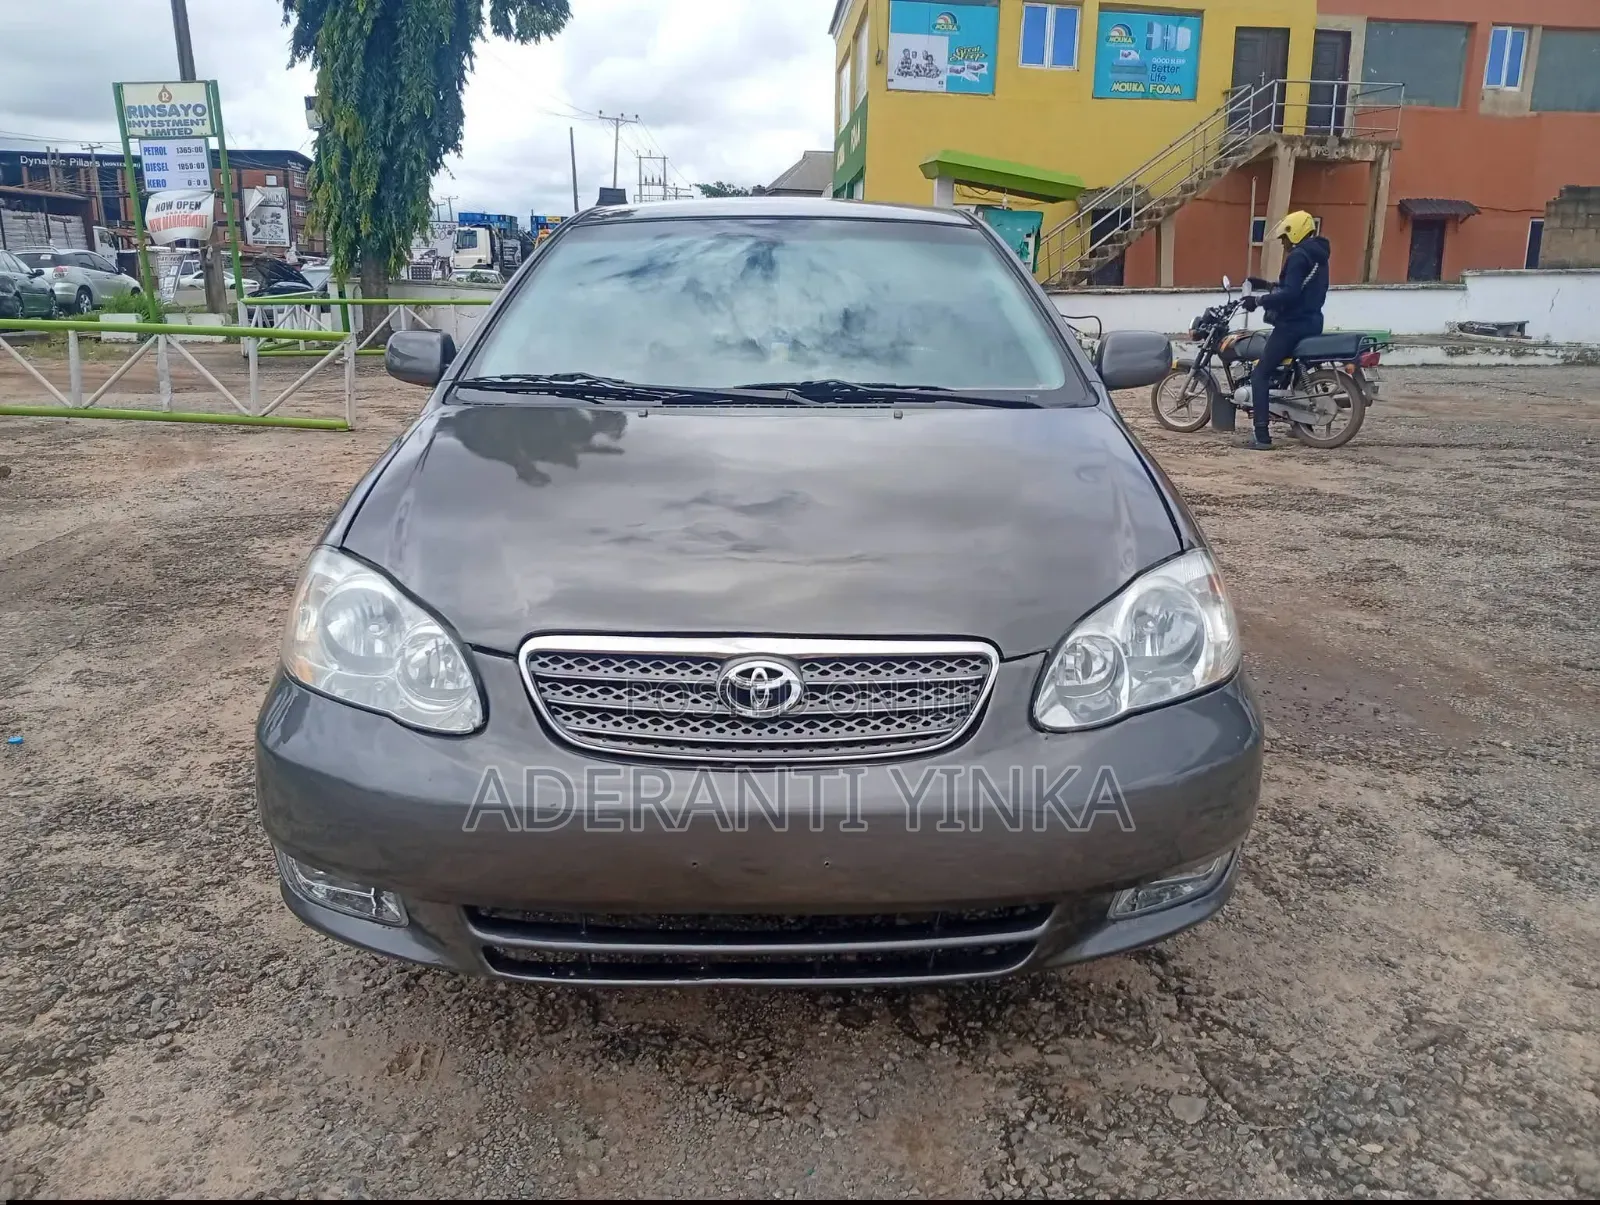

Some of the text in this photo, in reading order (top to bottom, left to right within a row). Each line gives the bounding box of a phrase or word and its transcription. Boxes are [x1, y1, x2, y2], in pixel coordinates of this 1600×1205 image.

[1108, 35, 1133, 43] MOUKA
[1151, 63, 1180, 74] Better
[1150, 72, 1167, 82] Life
[1110, 81, 1181, 95] MOUKA FOAM
[126, 103, 207, 119] RINSAYO
[127, 118, 207, 129] INVESTMENT
[144, 127, 193, 137] LIMITED
[143, 146, 167, 156] PETROL
[145, 162, 169, 172] DIESEL
[147, 178, 167, 188] KERO
[155, 201, 173, 213] NOW
[176, 200, 202, 211] OPEN
